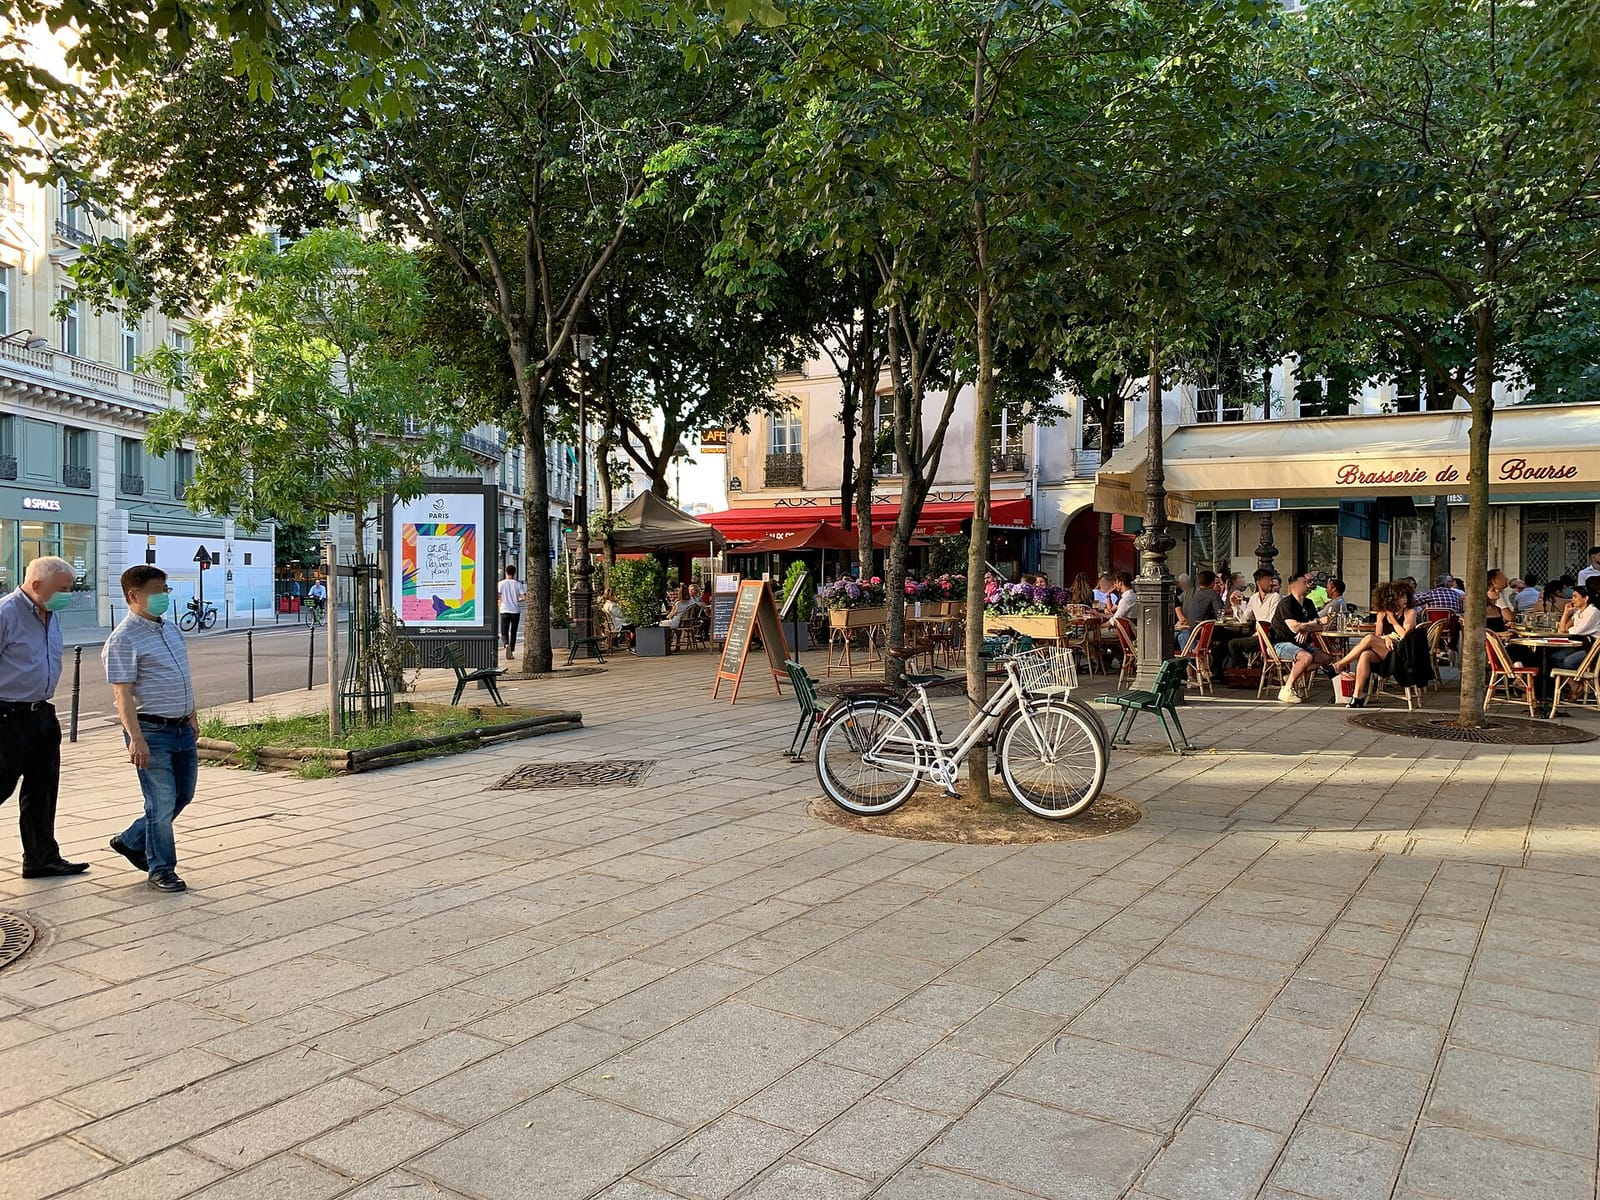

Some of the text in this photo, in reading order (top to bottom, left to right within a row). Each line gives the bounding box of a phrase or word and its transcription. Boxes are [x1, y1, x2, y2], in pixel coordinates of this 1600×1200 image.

[1335, 464, 1429, 485] Brasserie
[1435, 465, 1460, 483] de
[1499, 458, 1578, 480] Bourse
[774, 497, 817, 508] AUX
[428, 512, 450, 520] PARIS
